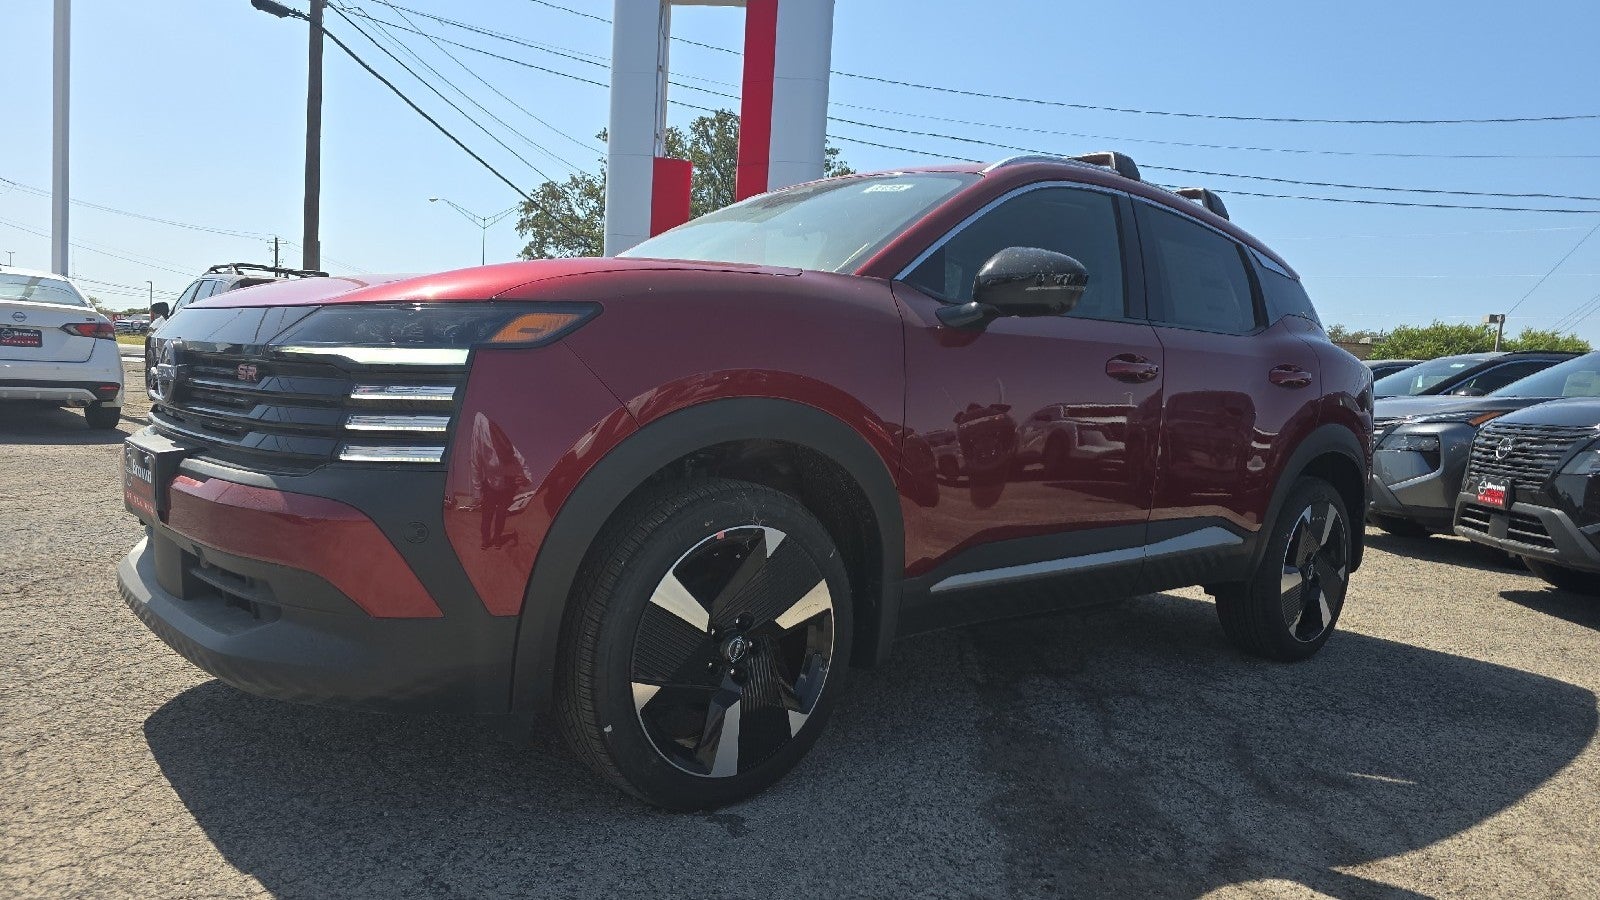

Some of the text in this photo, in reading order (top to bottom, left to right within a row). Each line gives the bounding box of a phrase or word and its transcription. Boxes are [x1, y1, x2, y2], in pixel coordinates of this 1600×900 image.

[238, 364, 257, 381] SR
[132, 459, 152, 484] Brown
[1486, 482, 1506, 492] Brown
